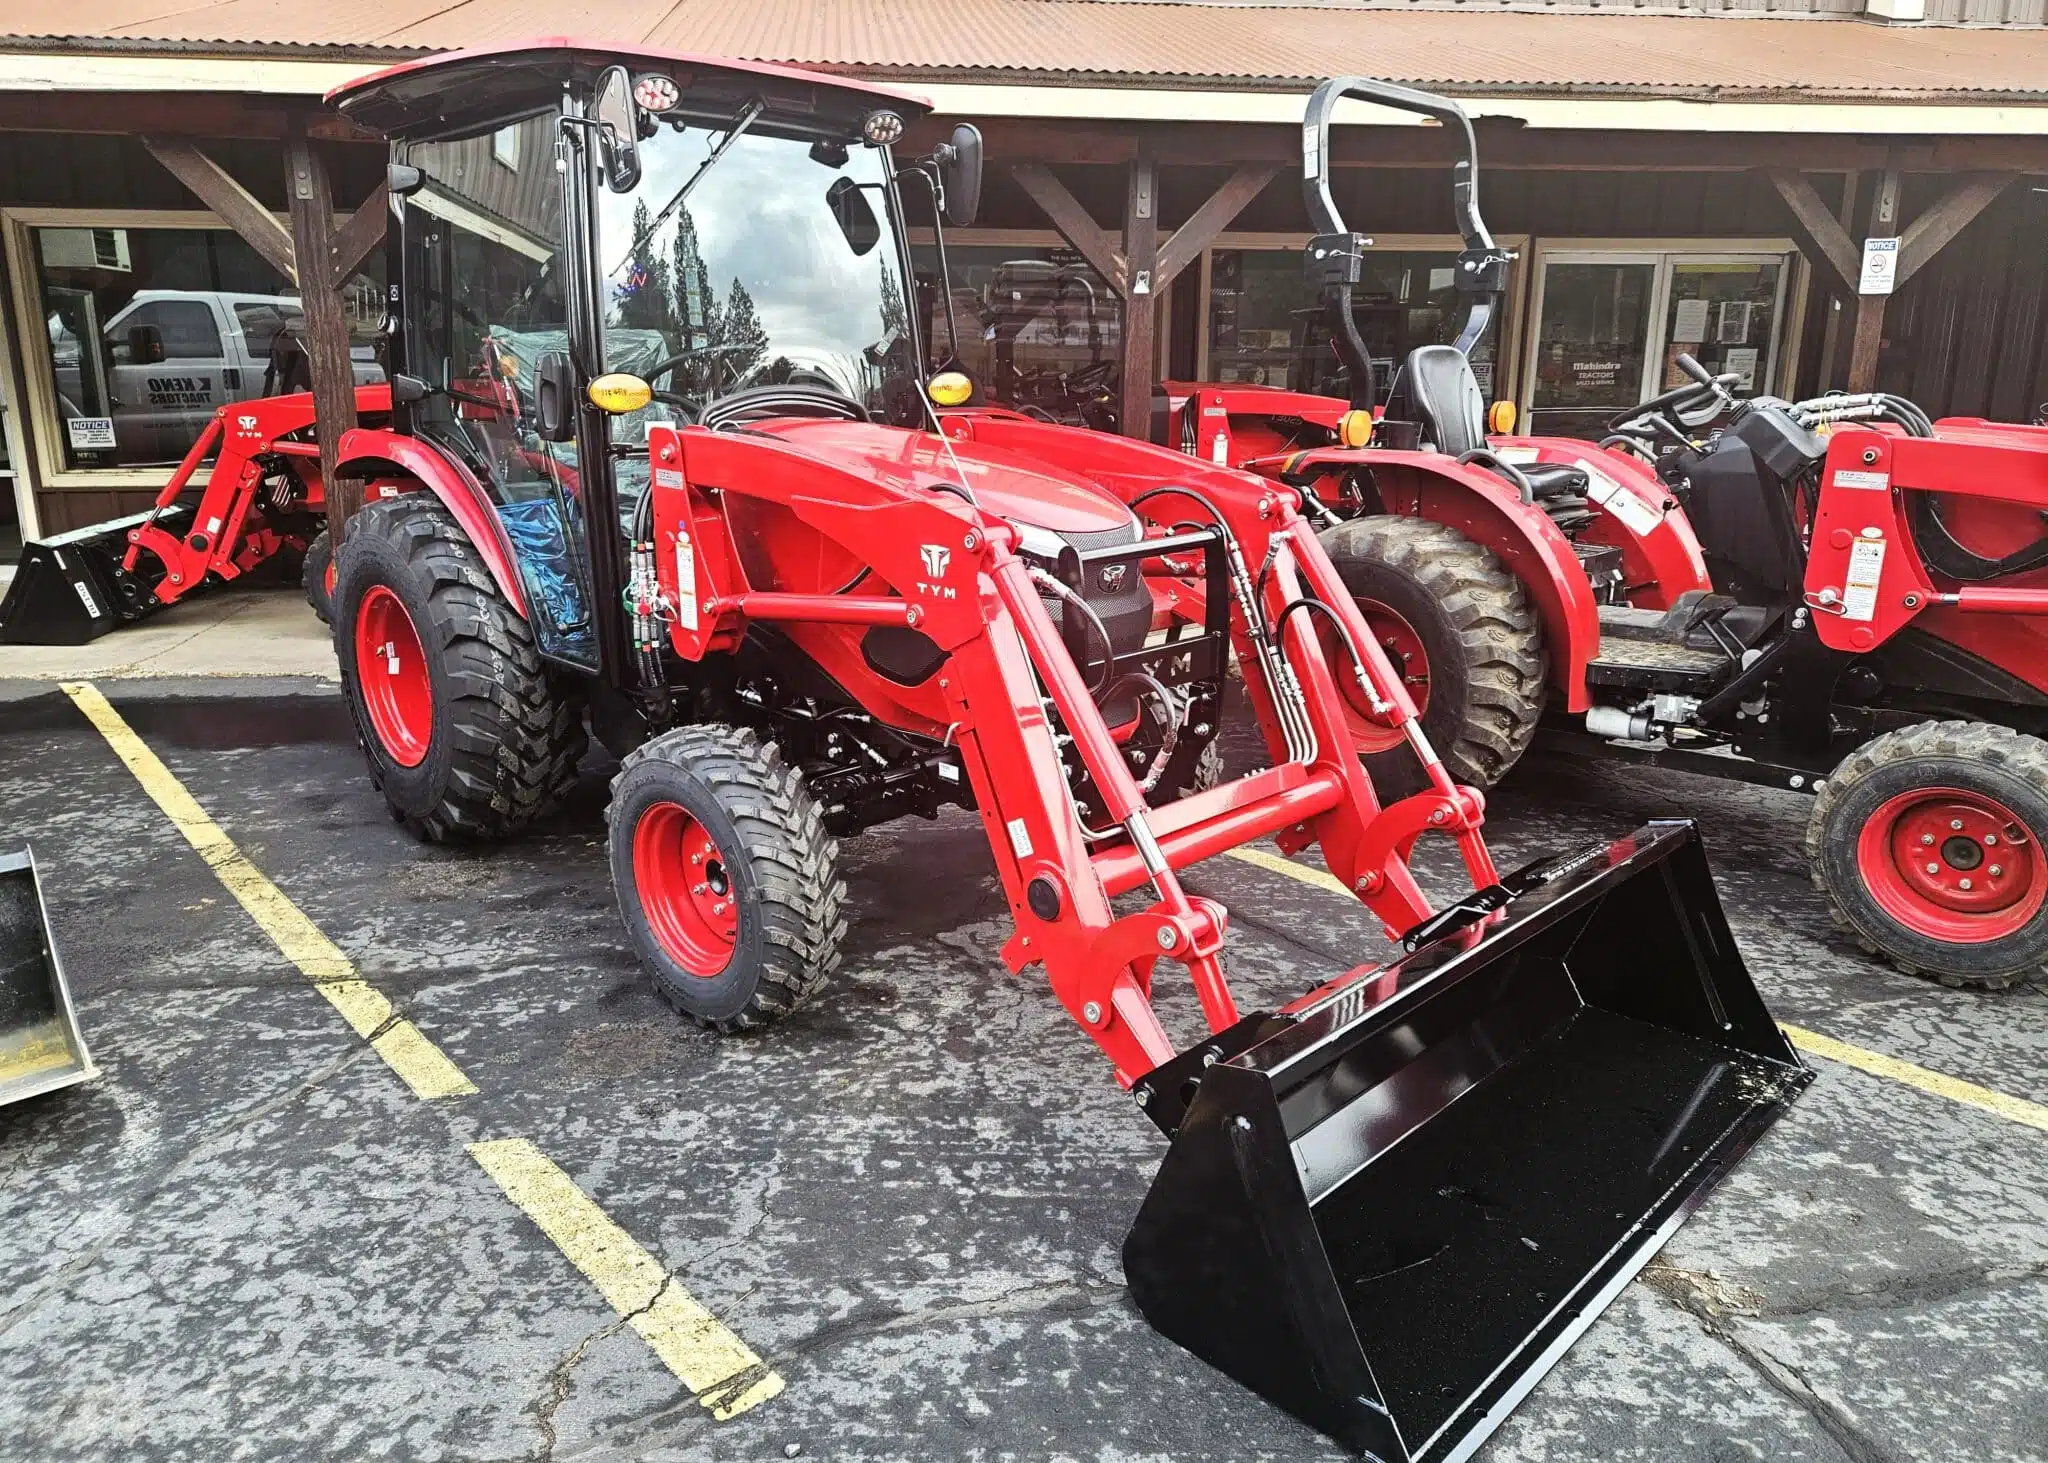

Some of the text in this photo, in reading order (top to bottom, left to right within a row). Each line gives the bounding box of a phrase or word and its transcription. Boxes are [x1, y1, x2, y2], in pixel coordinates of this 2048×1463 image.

[1867, 241, 1896, 250] NOTICE
[1573, 361, 1621, 370] Mahindra
[1578, 371, 1615, 379] TRACTORS
[73, 421, 109, 429] NOTICE
[916, 581, 956, 600] TYM
